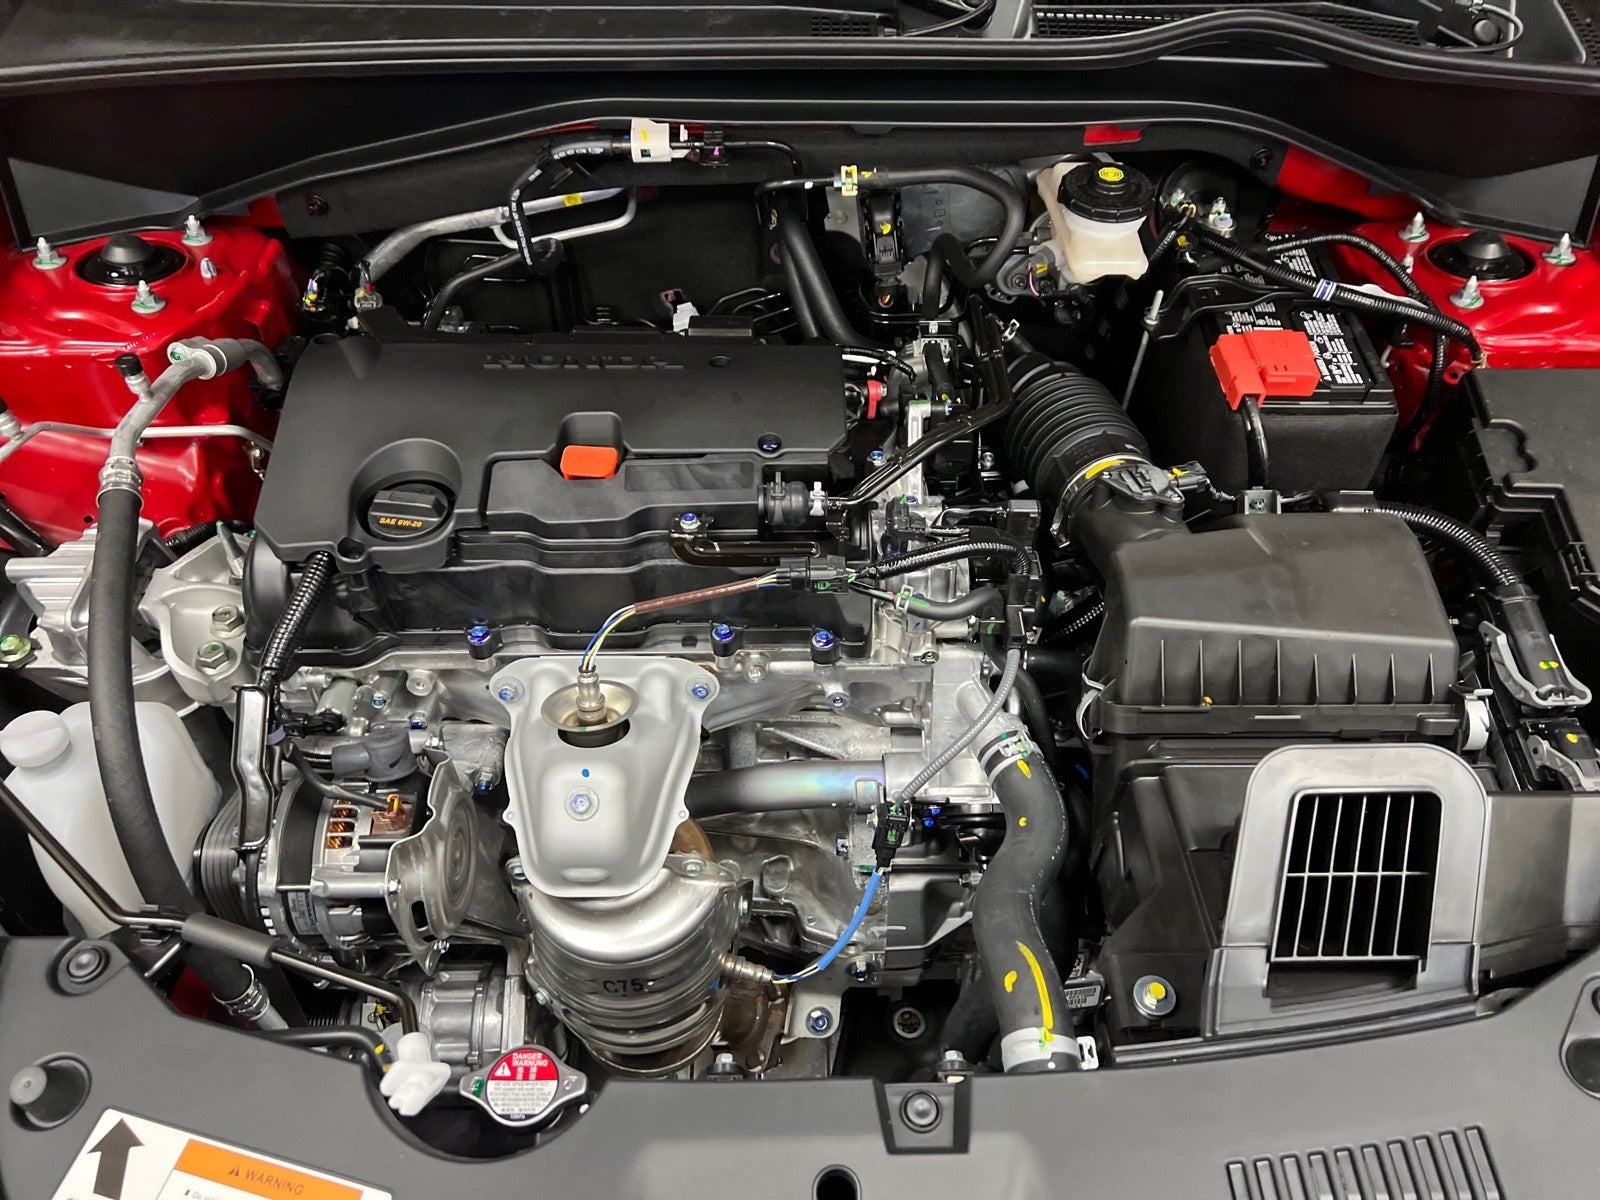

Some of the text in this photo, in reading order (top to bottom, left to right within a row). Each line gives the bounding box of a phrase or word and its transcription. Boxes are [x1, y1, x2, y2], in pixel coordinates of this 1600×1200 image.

[379, 517, 423, 528] SAE 0W-20
[512, 1052, 542, 1060] DANGER
[245, 1168, 304, 1195] WARNING
